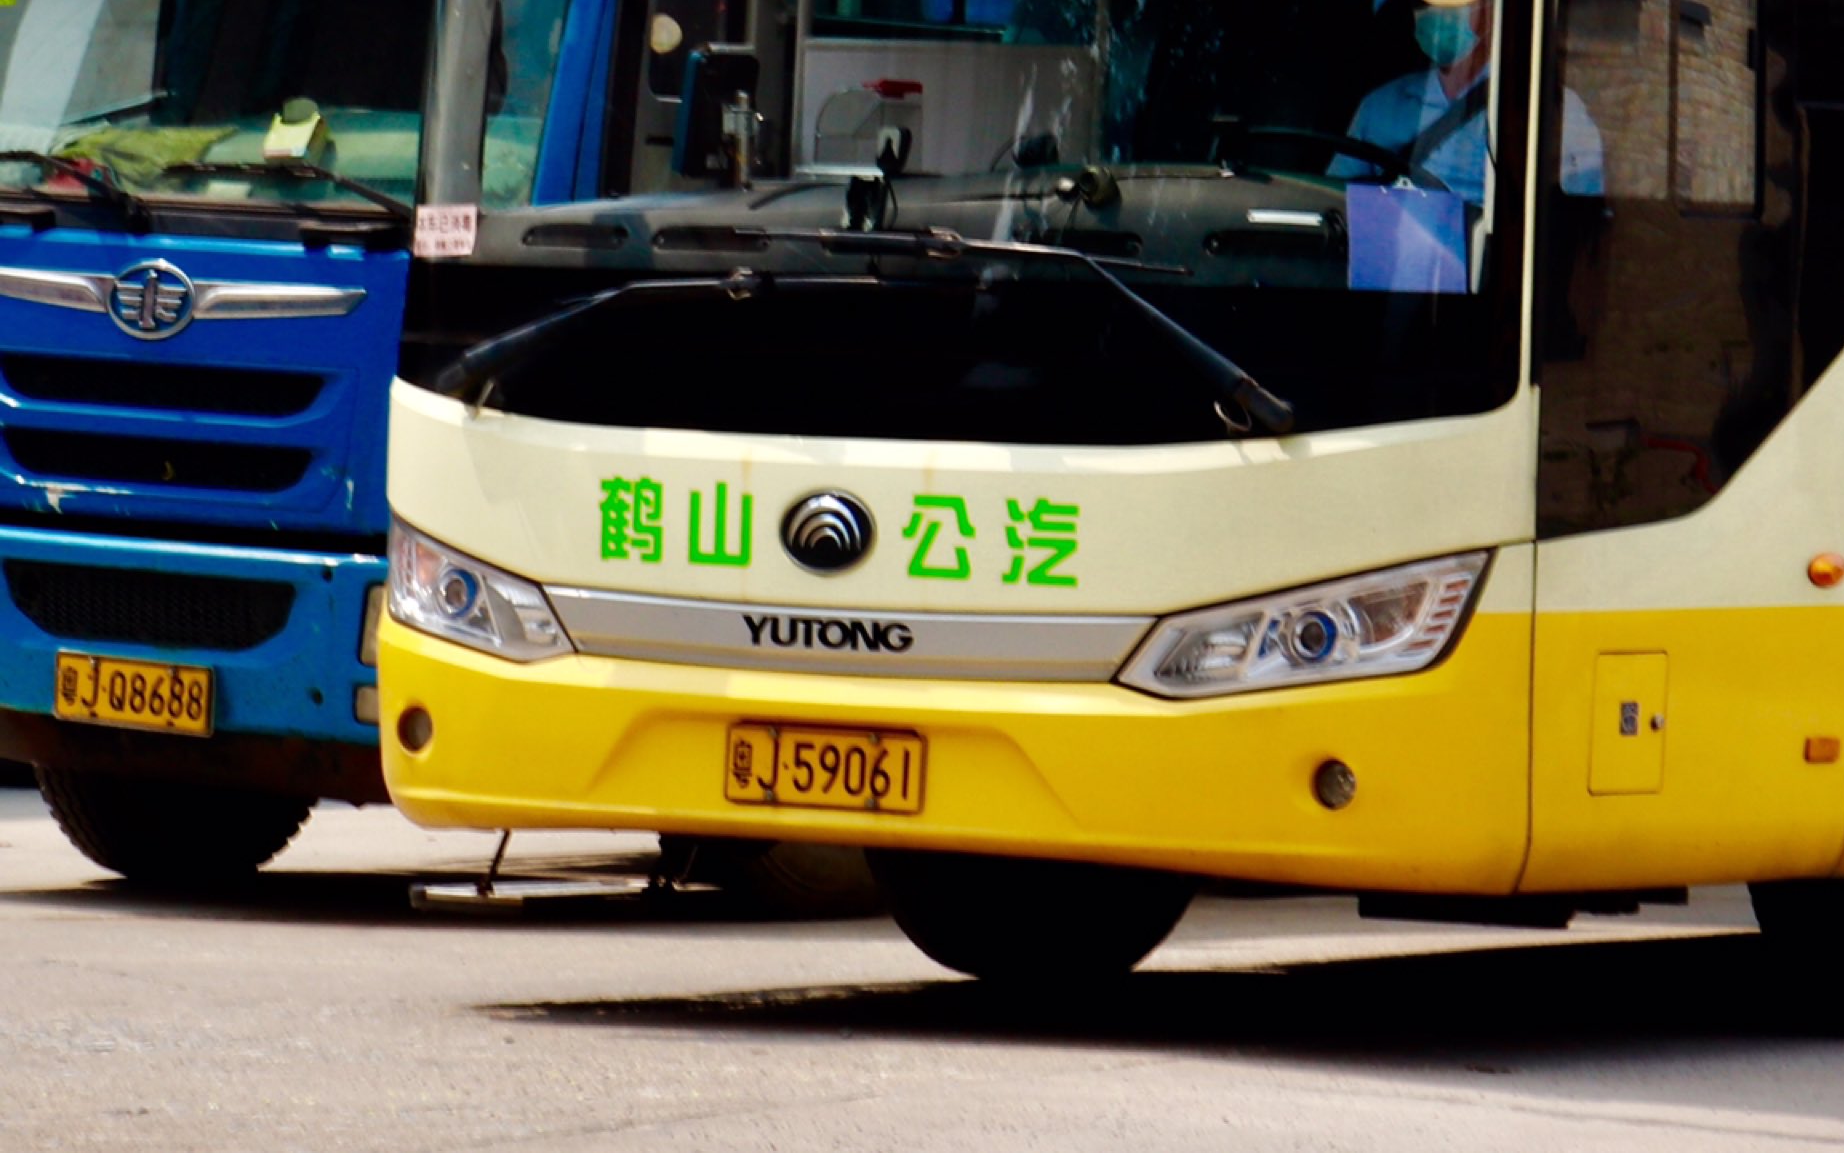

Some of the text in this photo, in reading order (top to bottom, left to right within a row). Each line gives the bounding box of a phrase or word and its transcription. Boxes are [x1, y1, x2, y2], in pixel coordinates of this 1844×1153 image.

[599, 477, 1079, 588] 鹤山 公汽
[743, 614, 914, 653] YUTONG
